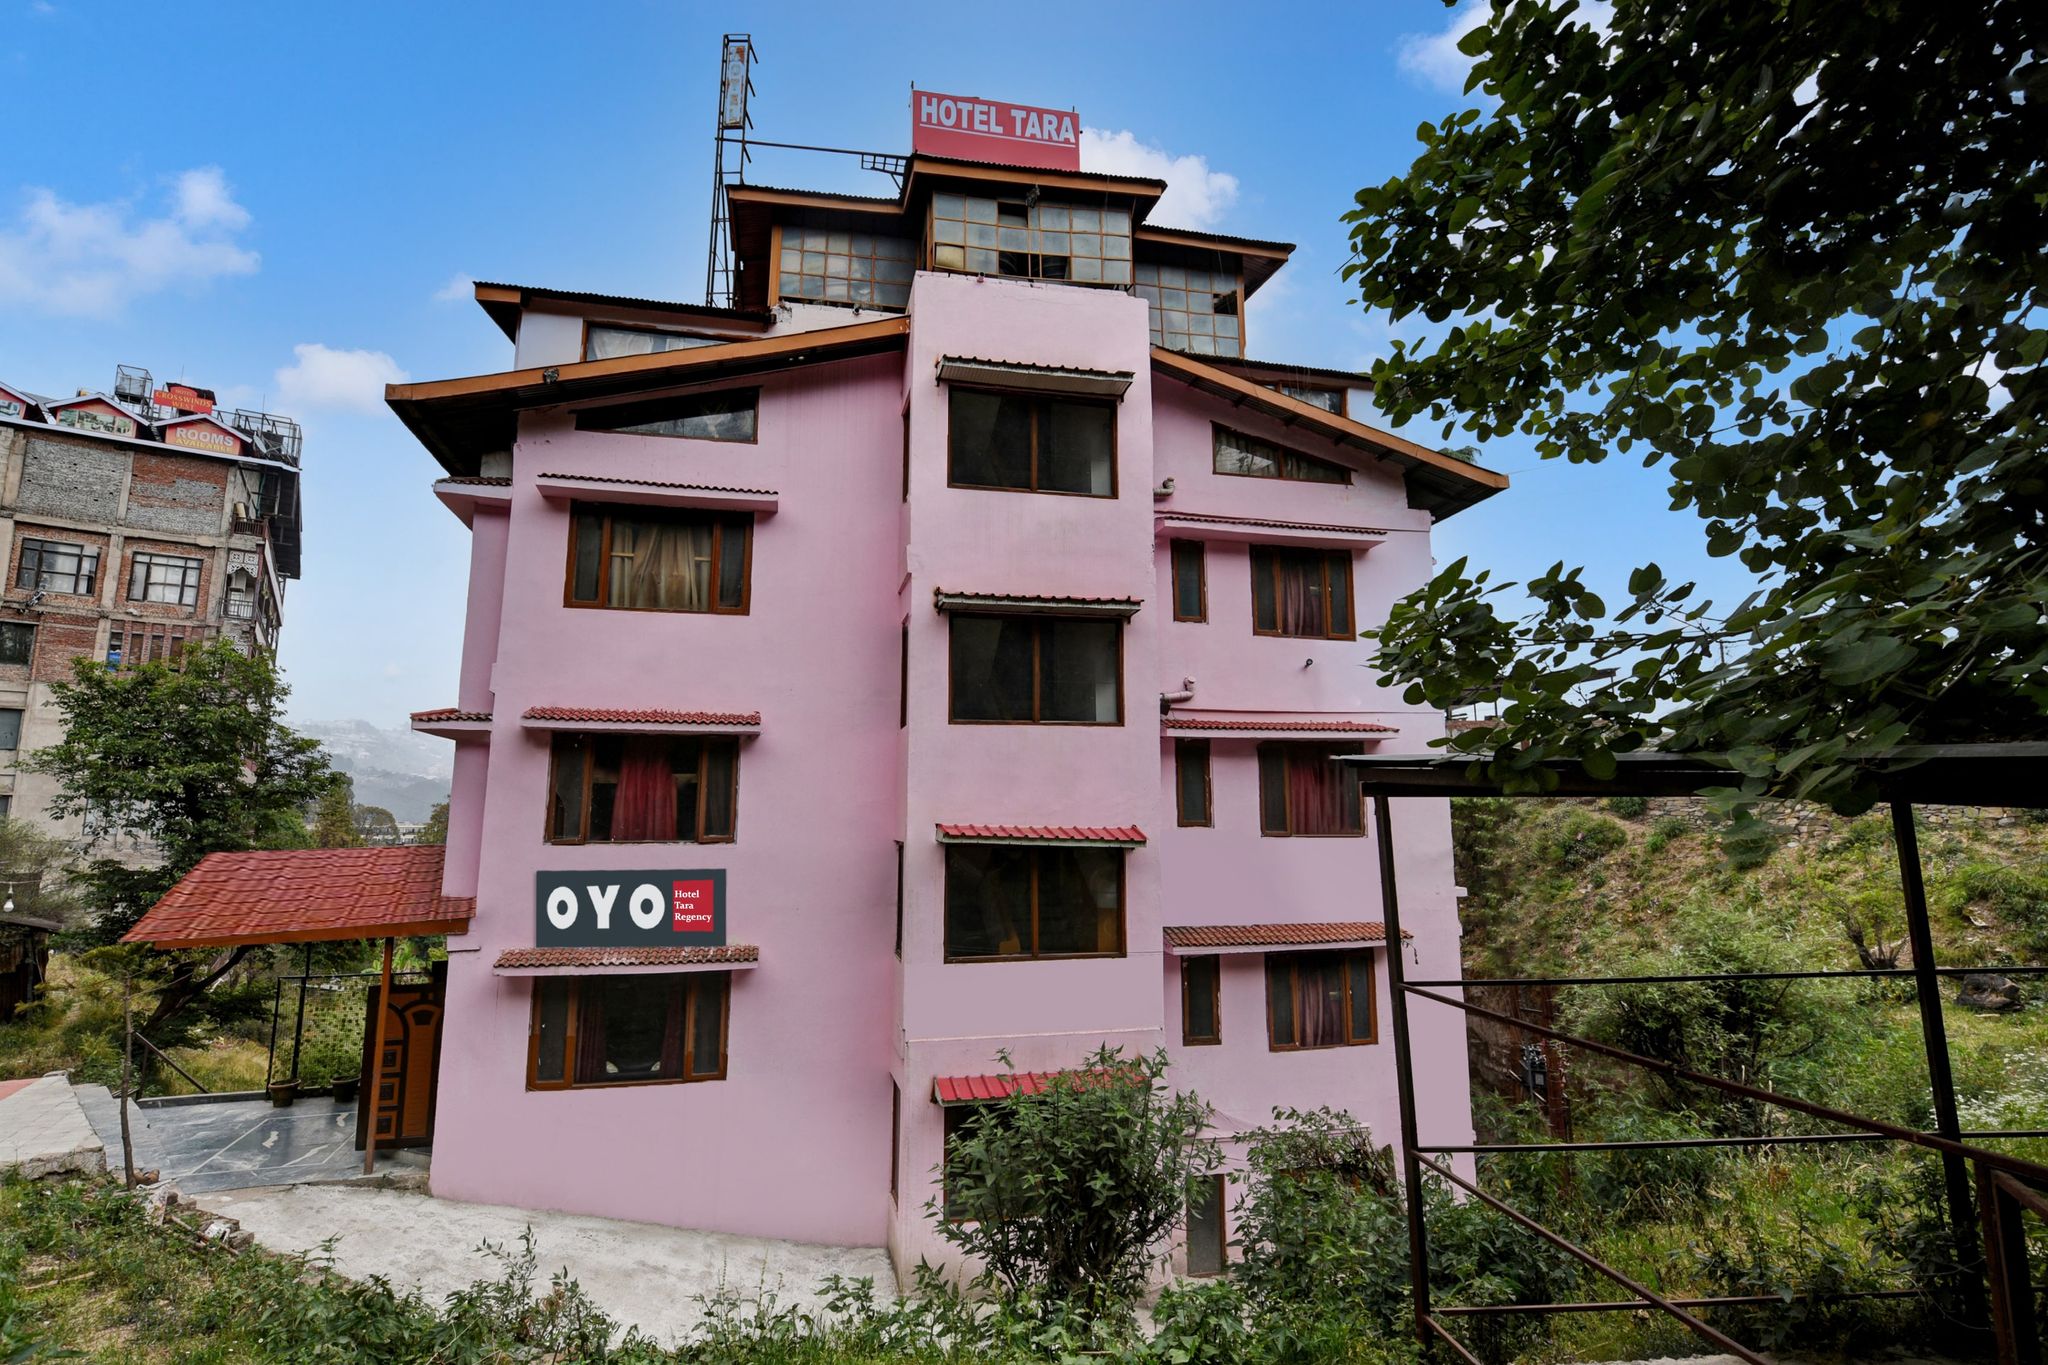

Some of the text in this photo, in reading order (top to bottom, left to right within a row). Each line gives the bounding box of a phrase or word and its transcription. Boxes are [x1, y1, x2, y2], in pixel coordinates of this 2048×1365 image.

[921, 95, 1076, 143] HOTEL TARA
[156, 391, 212, 408] CROSSWINDS
[172, 401, 195, 410] WEST
[176, 427, 234, 447] ROOMS
[175, 438, 234, 453] AVAILABLE
[674, 889, 700, 899] Hotel
[547, 883, 666, 930] OYO
[674, 901, 694, 910] Tara
[674, 912, 712, 923] Regency
